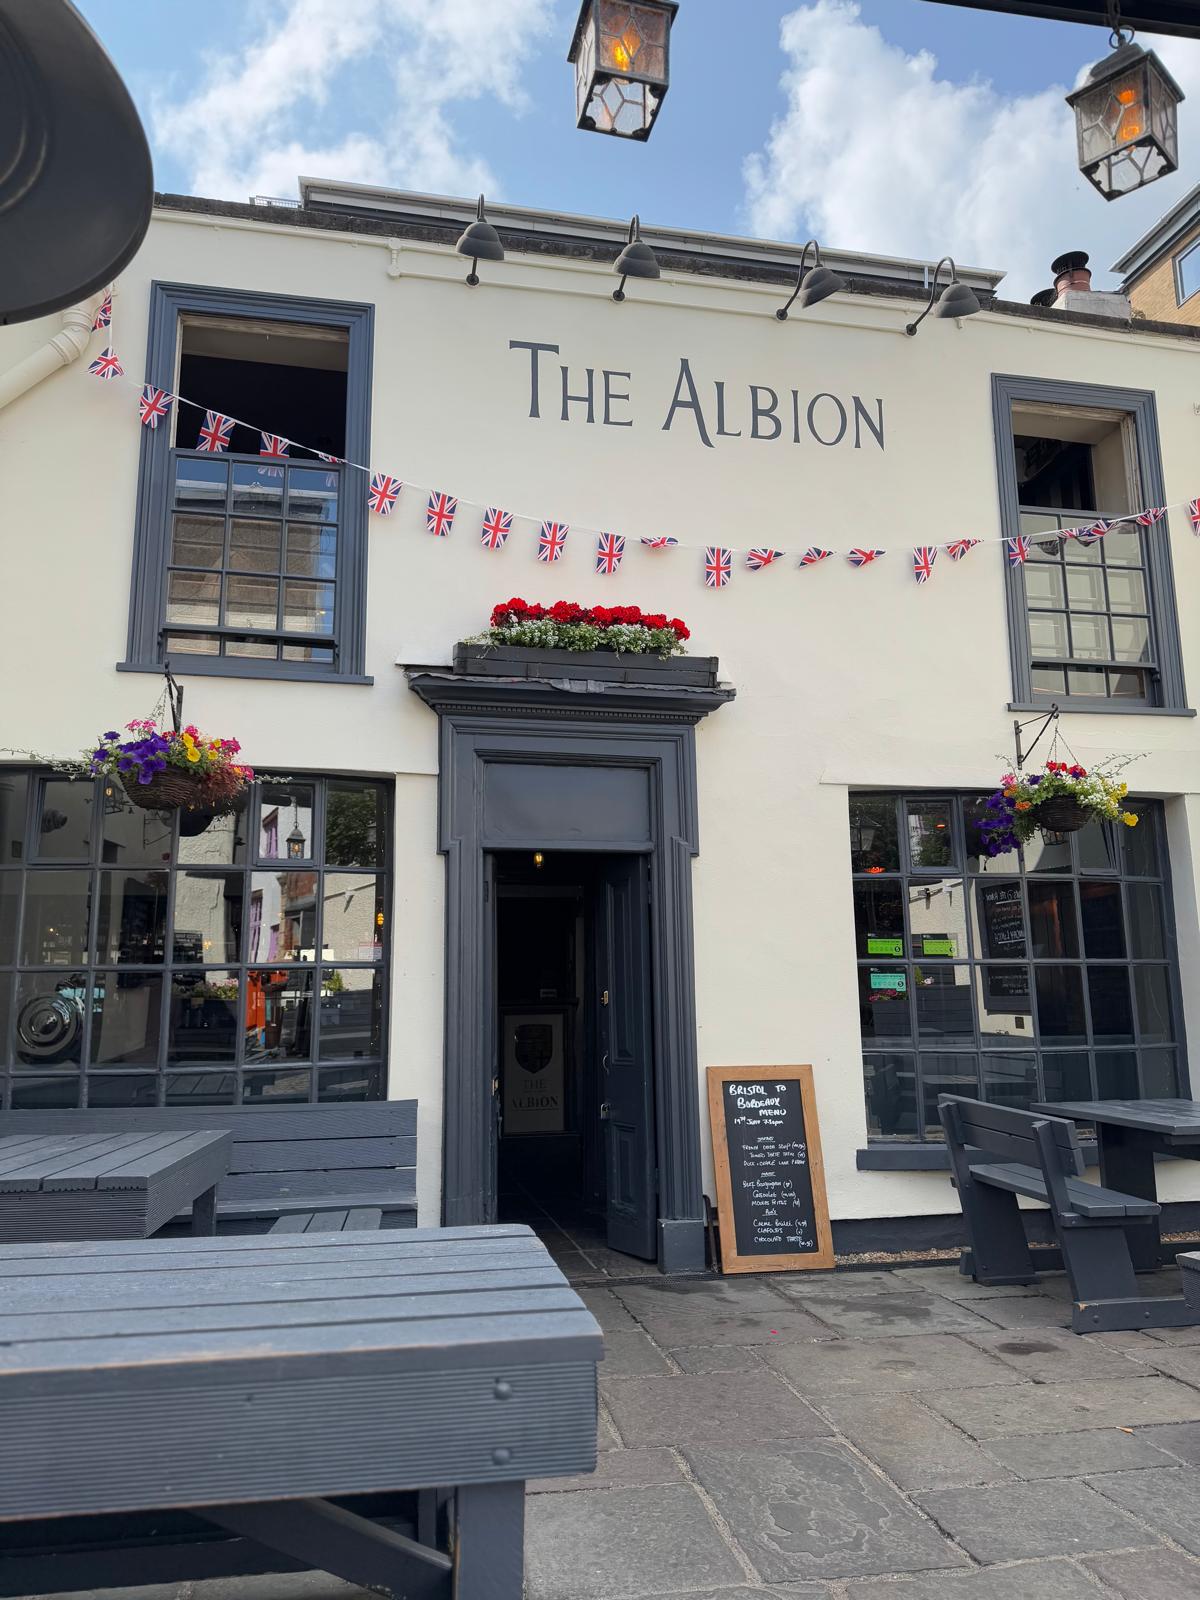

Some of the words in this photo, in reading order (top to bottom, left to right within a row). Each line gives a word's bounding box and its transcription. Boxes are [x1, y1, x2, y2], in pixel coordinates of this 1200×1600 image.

[509, 340, 633, 426] THE
[661, 358, 885, 451] ALBION
[523, 1079, 546, 1089] THE
[729, 1084, 768, 1096] BRISTOL
[775, 1084, 787, 1092] TO
[512, 1095, 558, 1108] ALBION
[737, 1097, 781, 1109] BORDEAUX
